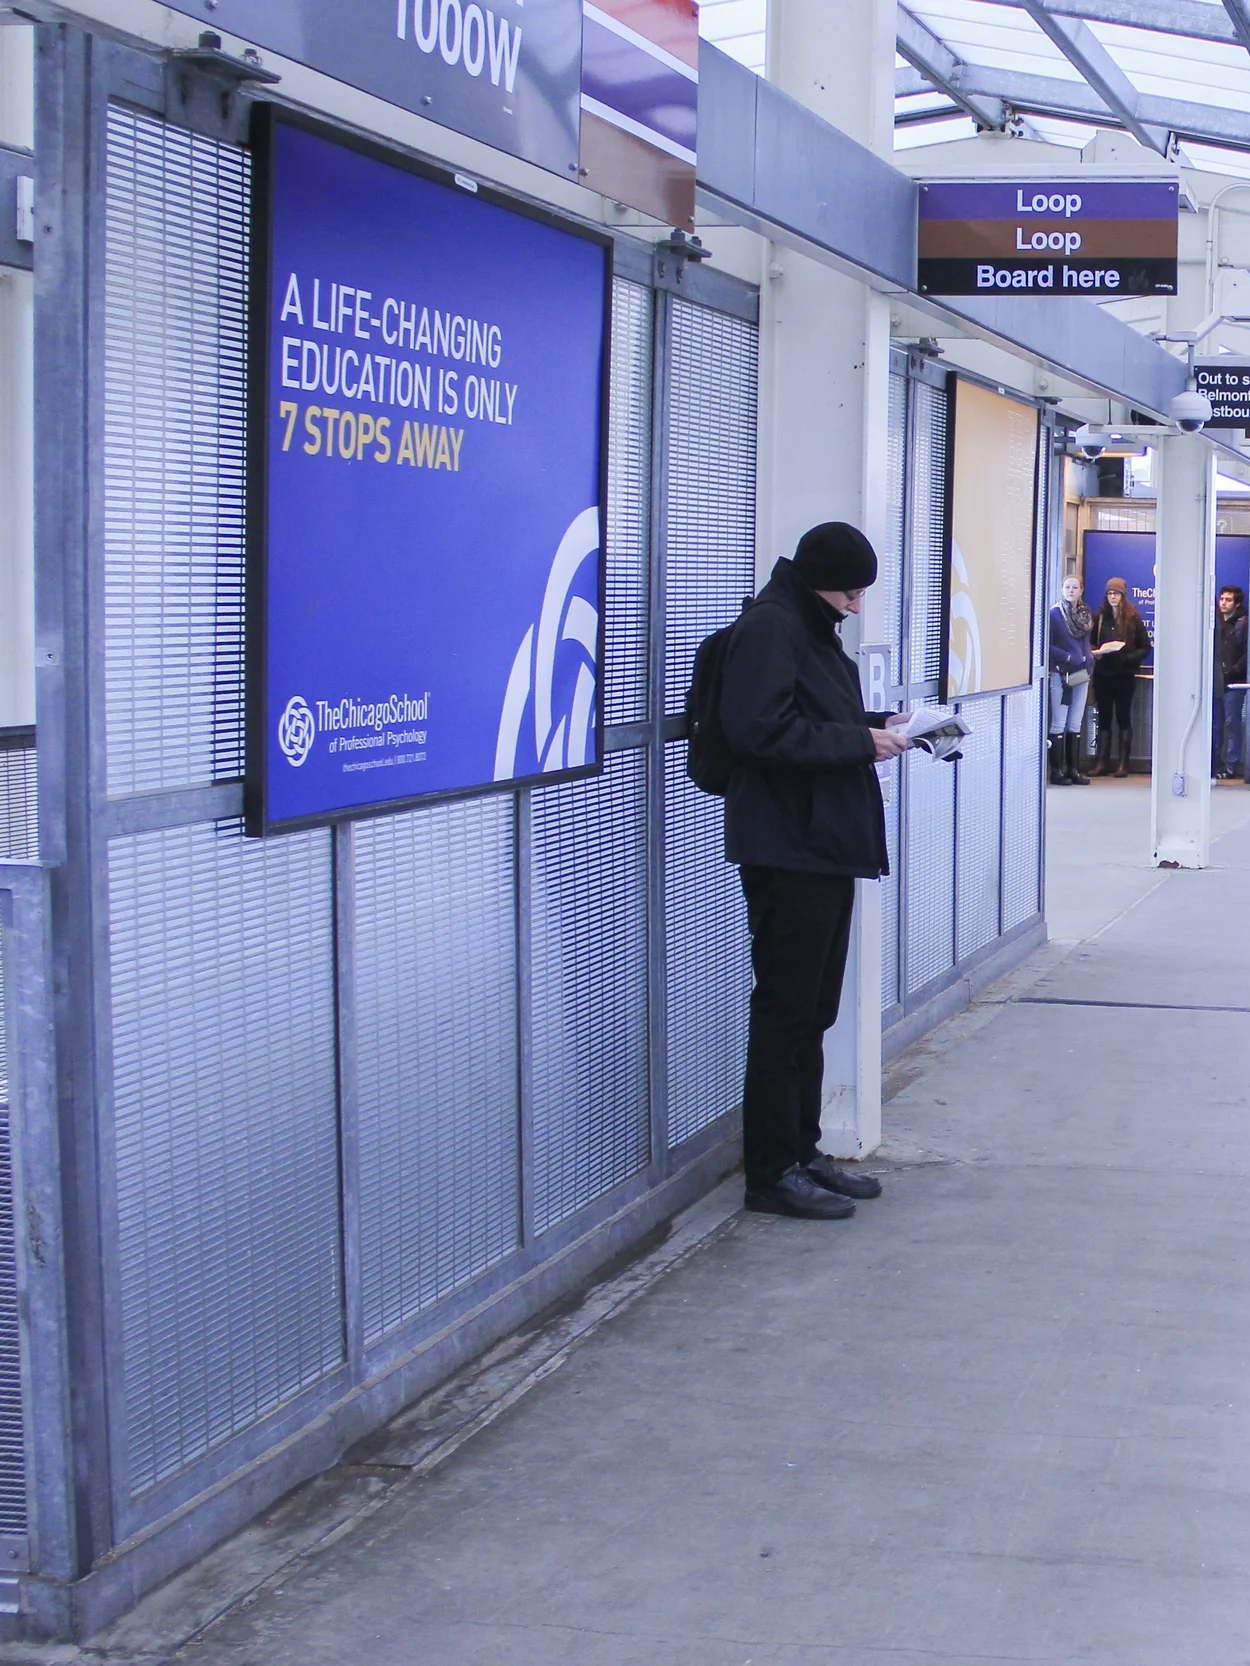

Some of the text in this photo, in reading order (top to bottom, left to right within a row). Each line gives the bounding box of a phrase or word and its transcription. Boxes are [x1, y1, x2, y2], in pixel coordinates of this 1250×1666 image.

[1017, 190, 1082, 217] Loop
[1016, 228, 1081, 255] Loop
[977, 265, 1120, 288] Board here
[281, 273, 502, 369] A LIFE-CHANGING
[281, 336, 518, 426] EDUCATION IS ONLY
[1198, 372, 1222, 385] Out
[1225, 373, 1239, 385] to
[280, 401, 464, 471] 7 STOPS AWAY
[316, 692, 428, 732] TheChicagoSchool
[329, 729, 427, 753] of Professional Psychology
